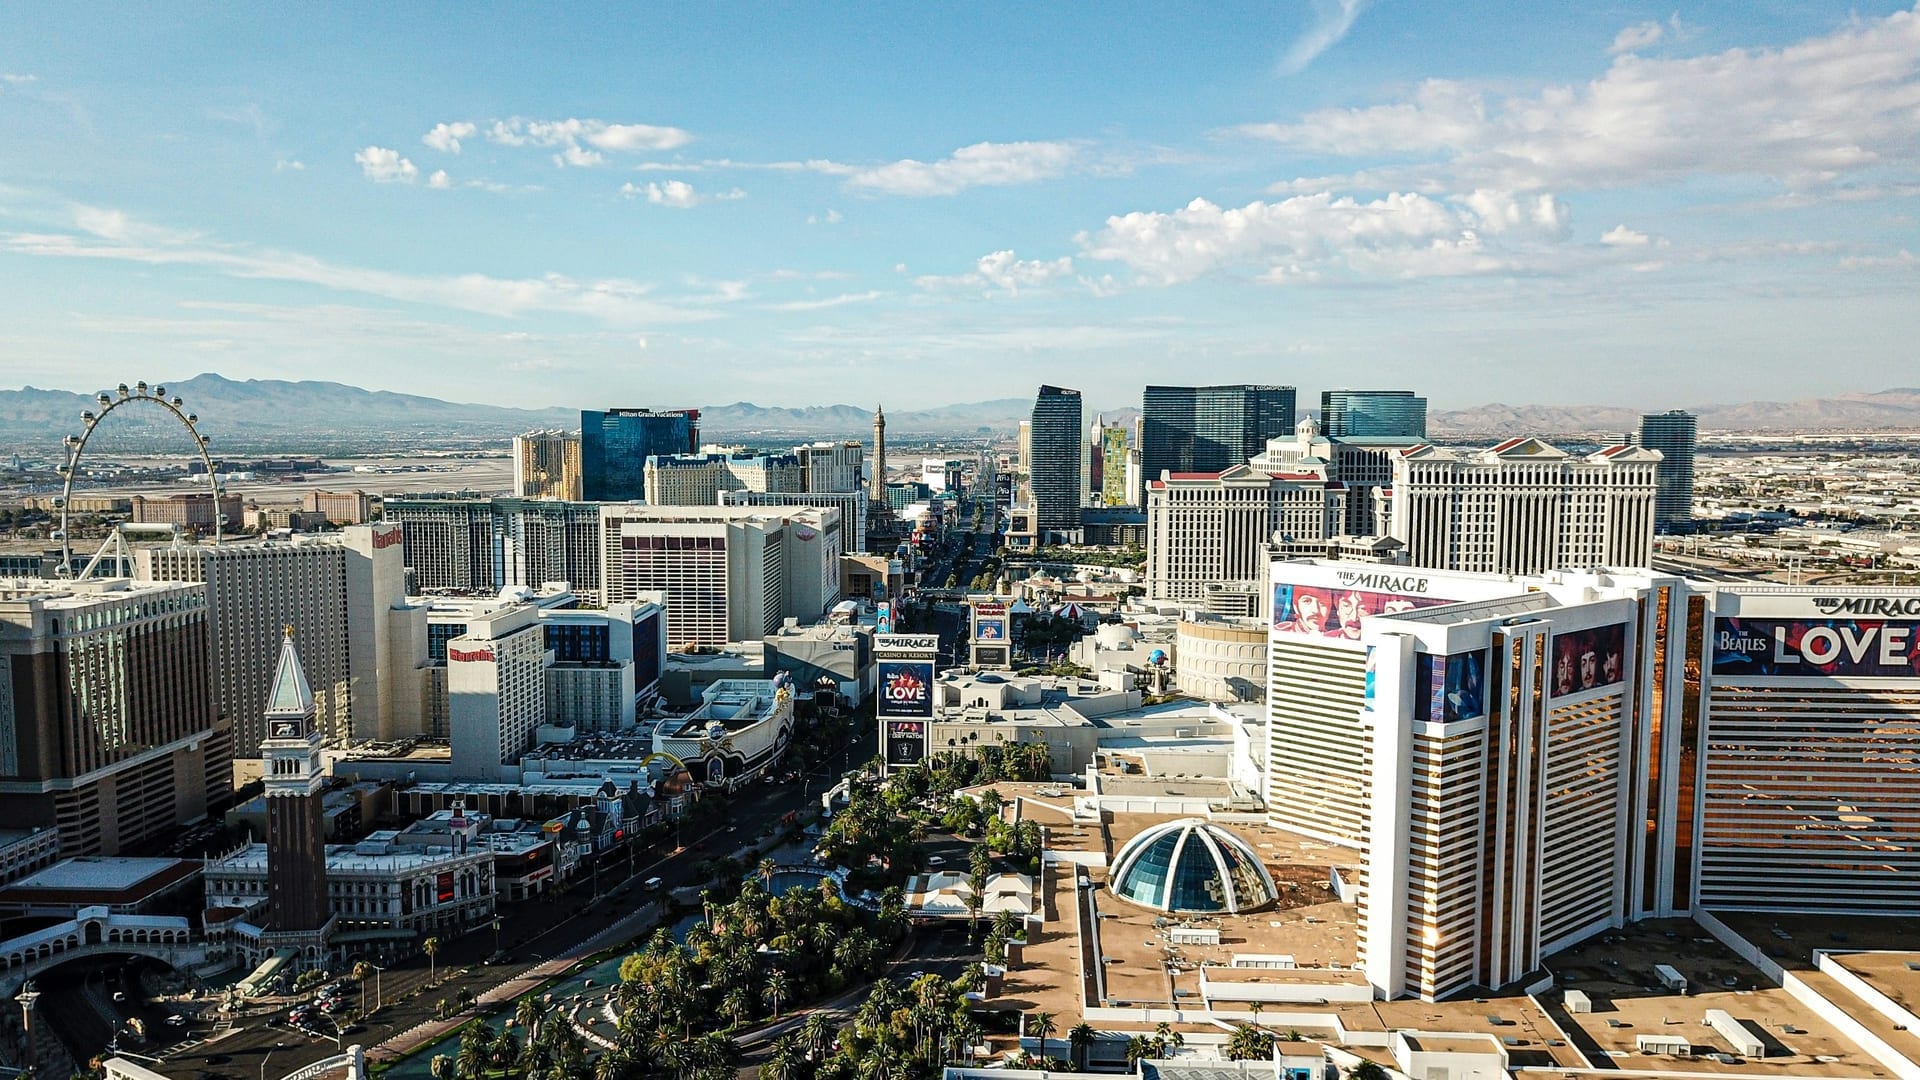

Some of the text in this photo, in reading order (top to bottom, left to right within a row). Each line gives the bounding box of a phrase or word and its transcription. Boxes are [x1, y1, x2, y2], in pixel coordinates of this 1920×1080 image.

[1337, 571, 1428, 593] THE MIRAGE
[1812, 597, 1920, 618] THE MIRAG
[881, 638, 935, 649] MIRAGE
[1720, 626, 1910, 666] BEATLES LOVE
[908, 651, 933, 659] RESORT
[885, 686, 925, 699] LOVE
